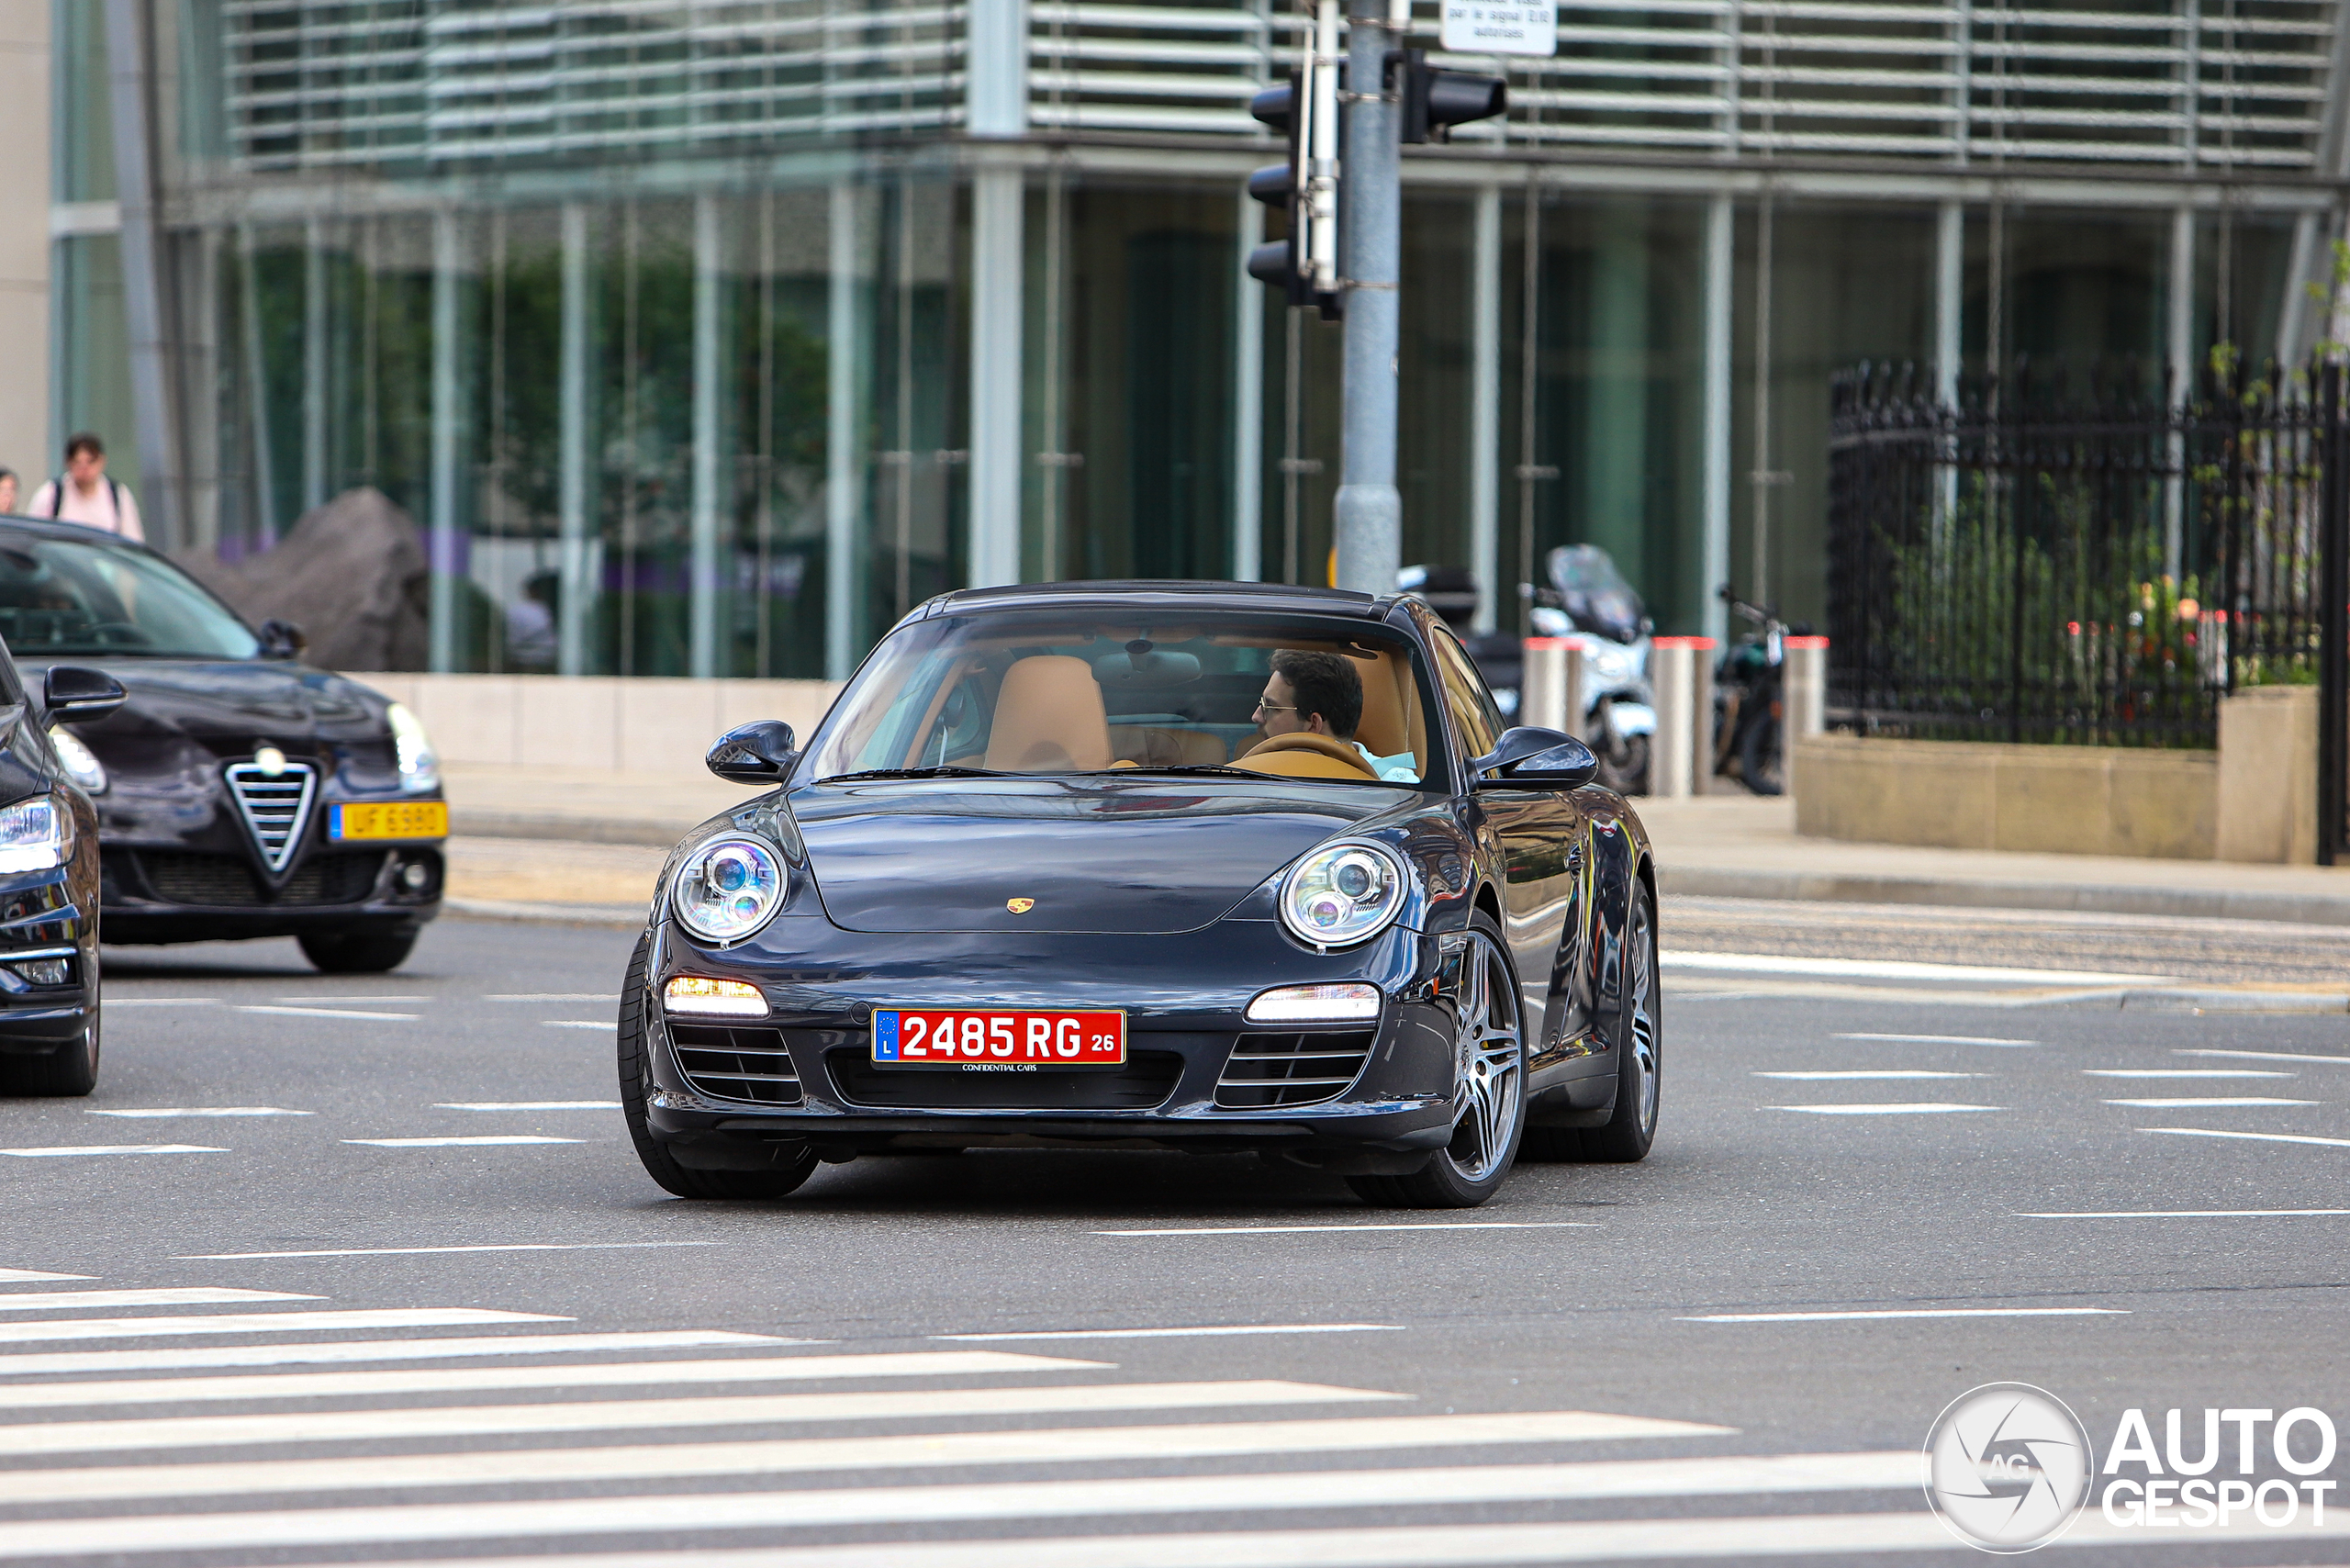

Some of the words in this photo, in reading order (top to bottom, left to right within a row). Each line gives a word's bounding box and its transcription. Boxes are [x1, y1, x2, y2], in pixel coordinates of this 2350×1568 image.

[1449, 7, 1467, 21] par
[1472, 6, 1483, 18] le
[1490, 8, 1522, 23] signal
[883, 1040, 891, 1054] L
[903, 1016, 1014, 1057] 2485
[1026, 1017, 1081, 1058] RG
[1091, 1034, 1114, 1052] 26
